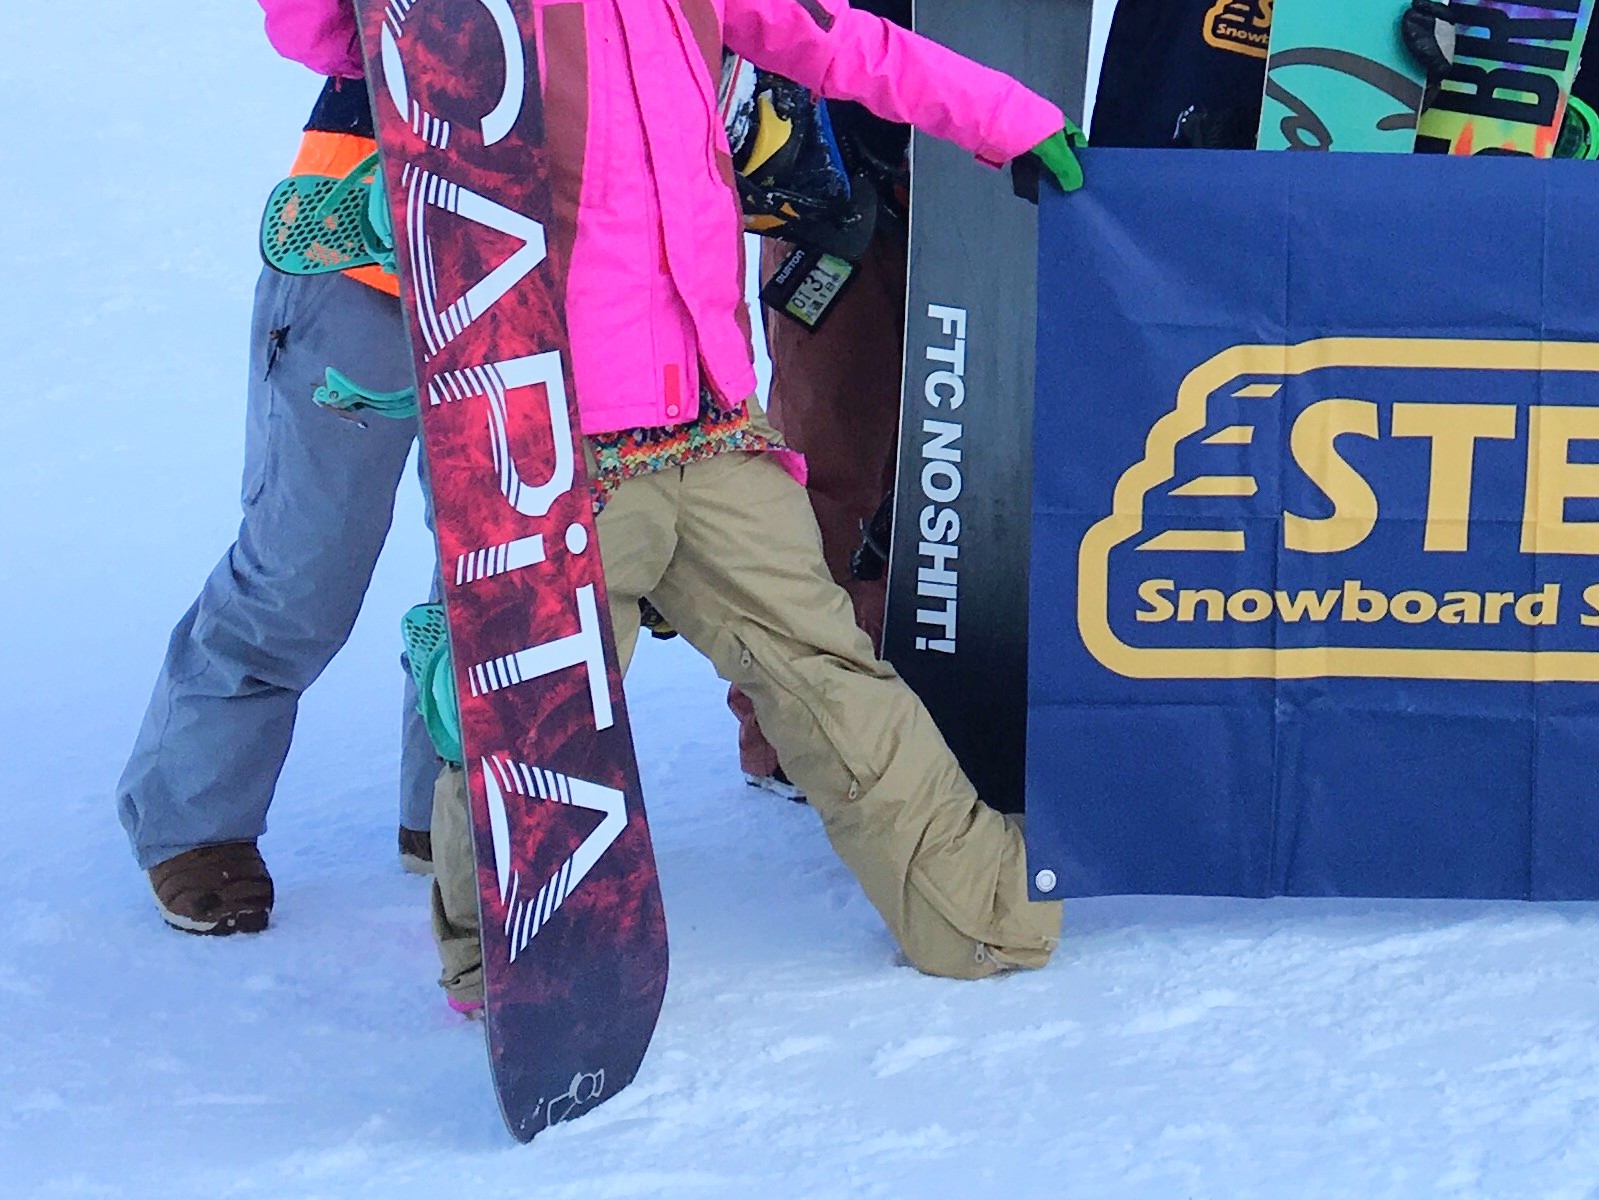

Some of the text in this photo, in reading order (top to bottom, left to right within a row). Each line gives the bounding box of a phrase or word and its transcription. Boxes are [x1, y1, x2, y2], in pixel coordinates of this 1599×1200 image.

[915, 304, 967, 654] FTC NOSHIT!
[1136, 580, 1559, 627] Snowboard
